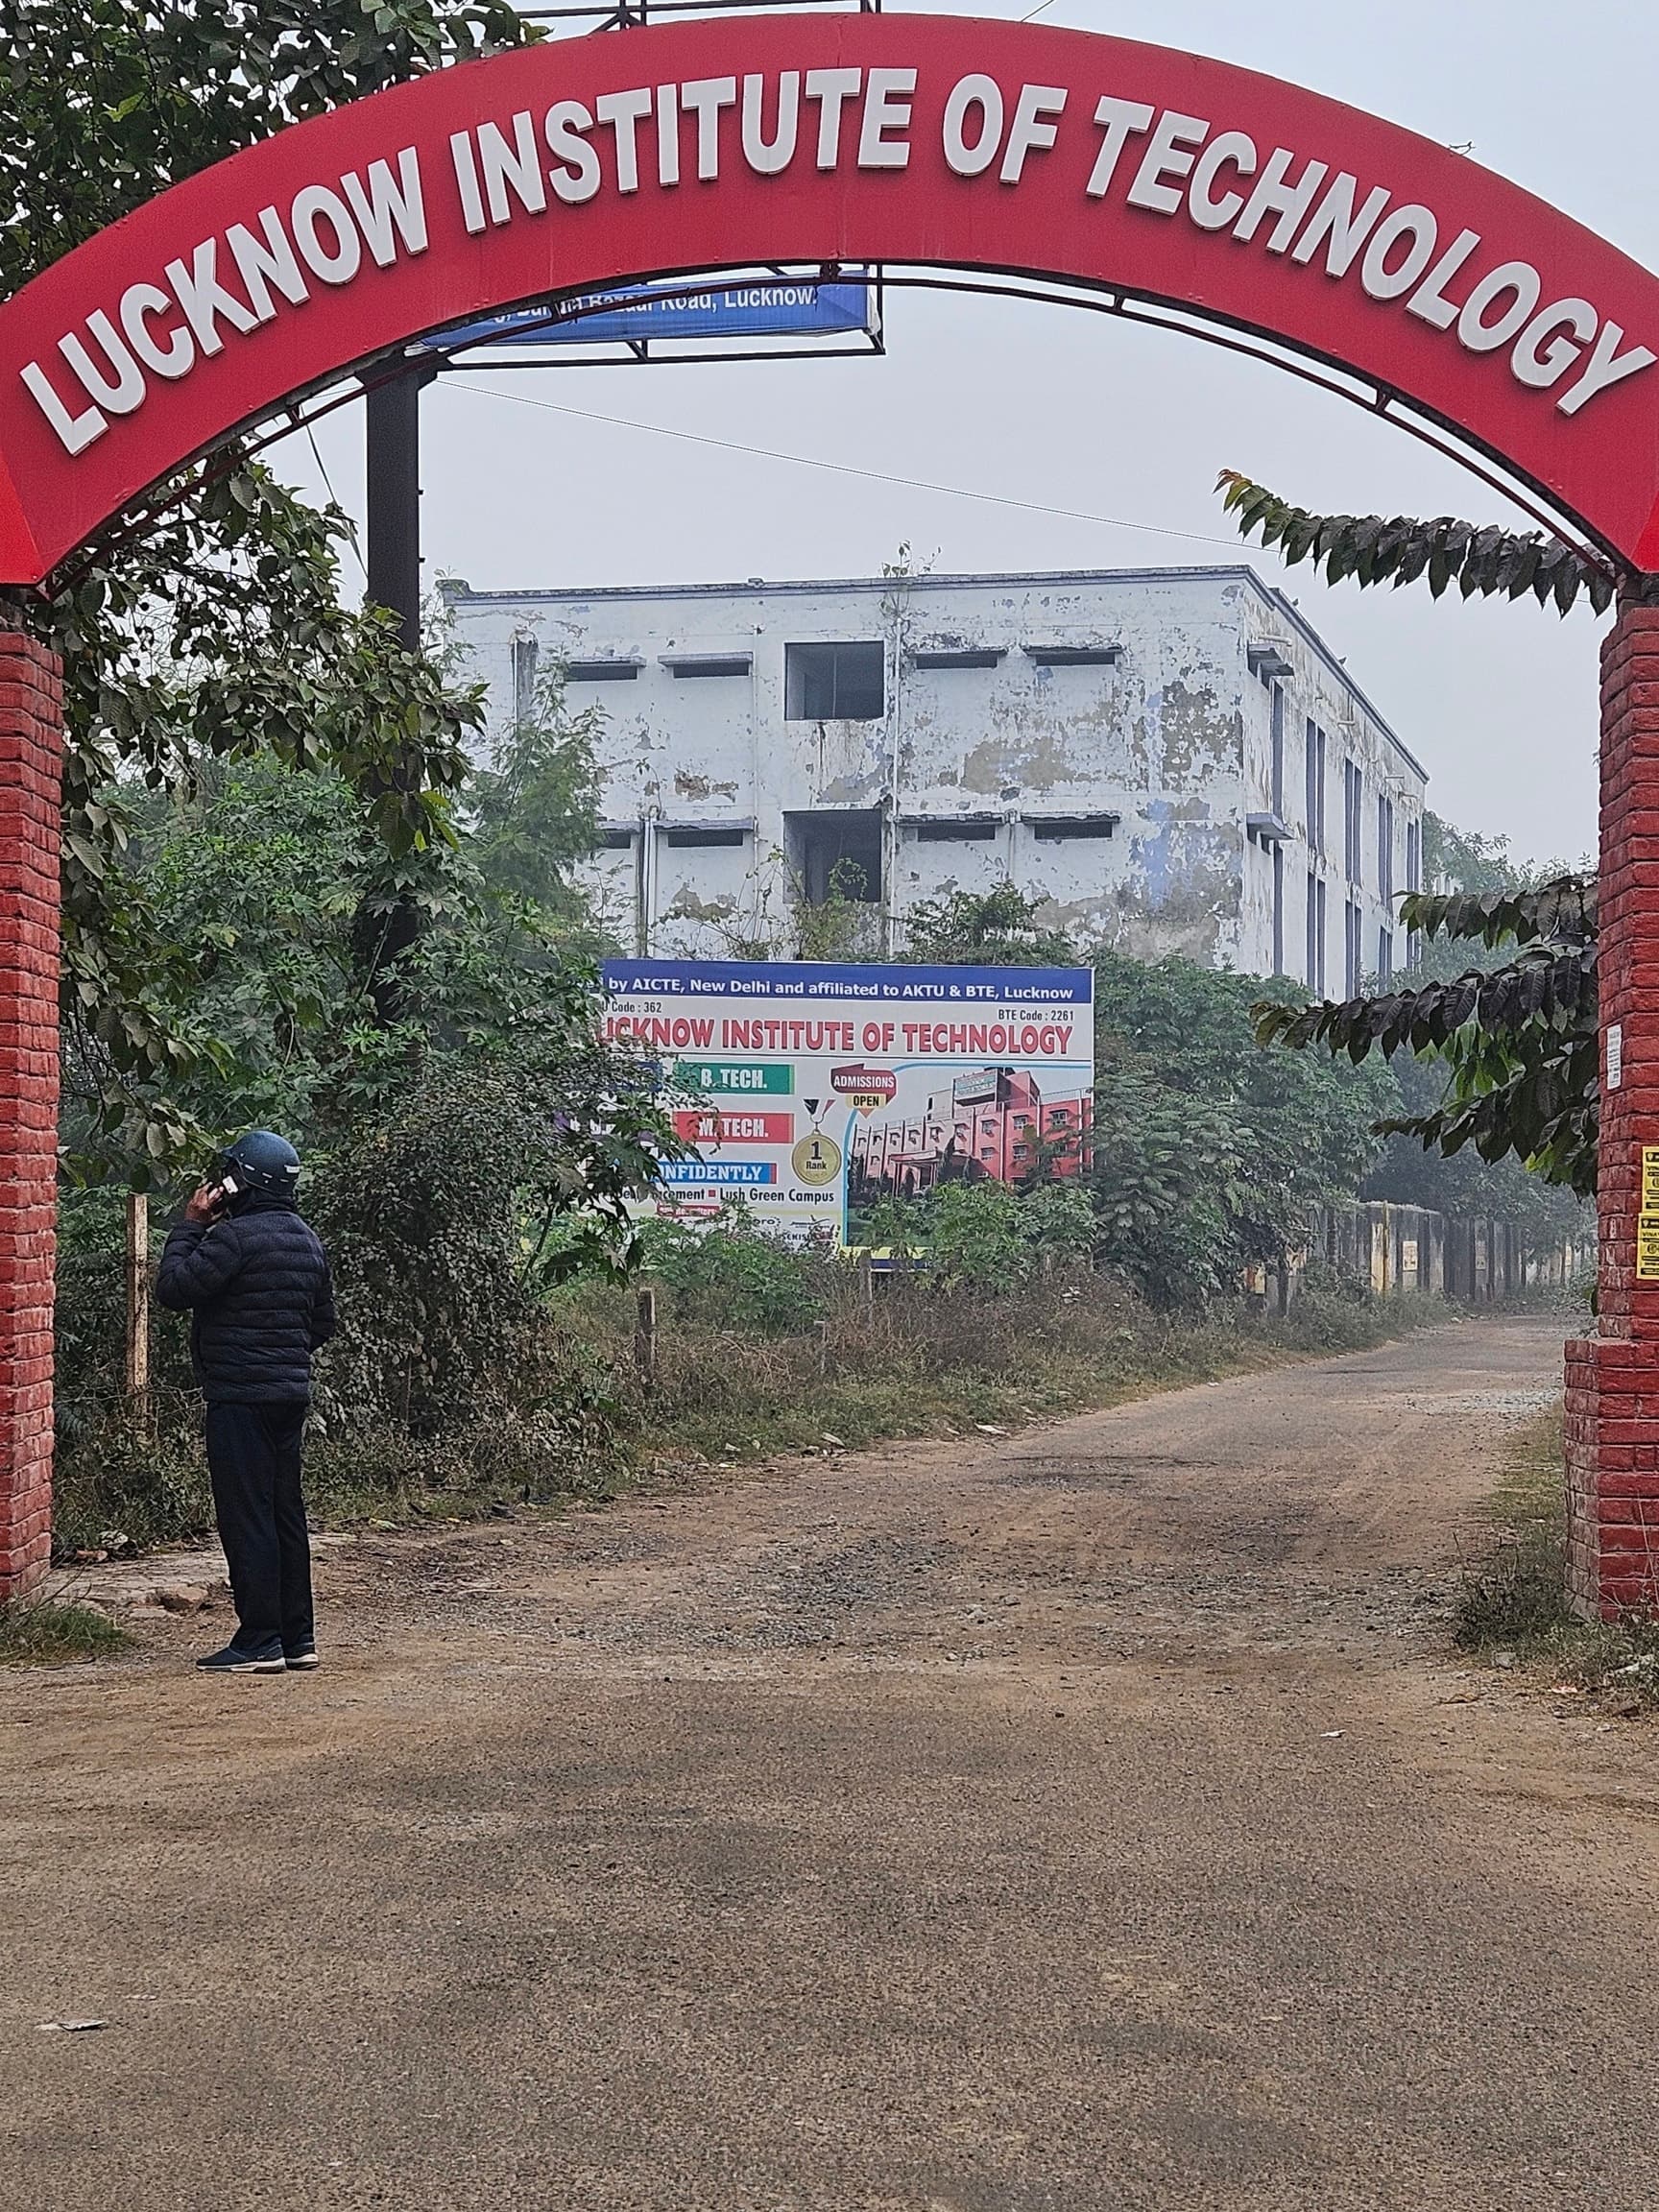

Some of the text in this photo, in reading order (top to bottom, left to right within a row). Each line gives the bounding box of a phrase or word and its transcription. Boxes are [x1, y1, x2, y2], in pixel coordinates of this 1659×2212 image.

[20, 67, 1659, 457] LUCKNOW INSTITUTE OF TECHNOLOGY
[724, 287, 817, 308] Lucknow.
[609, 977, 628, 993] by
[632, 978, 685, 993] AICTE,
[690, 979, 726, 992] New
[731, 980, 771, 994] Delhi
[775, 982, 805, 994] and
[808, 982, 878, 996] affiliated
[882, 984, 899, 997] to
[902, 985, 945, 997] AKTU
[949, 985, 961, 997] &
[966, 985, 999, 999] BTE,
[1004, 986, 1073, 999] Lucknow
[612, 1001, 635, 1012] Code
[643, 1001, 662, 1013] 362
[998, 1009, 1017, 1020] BTE
[1020, 1009, 1043, 1021] Code
[1050, 1010, 1074, 1021] 2261
[596, 1017, 1073, 1054] UCKNOW INSTITUTE OF TECHNOLOGY
[720, 1069, 768, 1089] TECH.
[833, 1074, 895, 1088] ADMISSIONS
[853, 1095, 879, 1107] OPEN
[721, 1118, 769, 1138] TECH.
[810, 1141, 823, 1160] 1
[657, 1163, 763, 1182] ONFIDENTLY
[805, 1161, 828, 1170] Rank
[719, 1188, 746, 1201] Lush
[749, 1188, 784, 1201] Green
[788, 1189, 834, 1205] Campus
